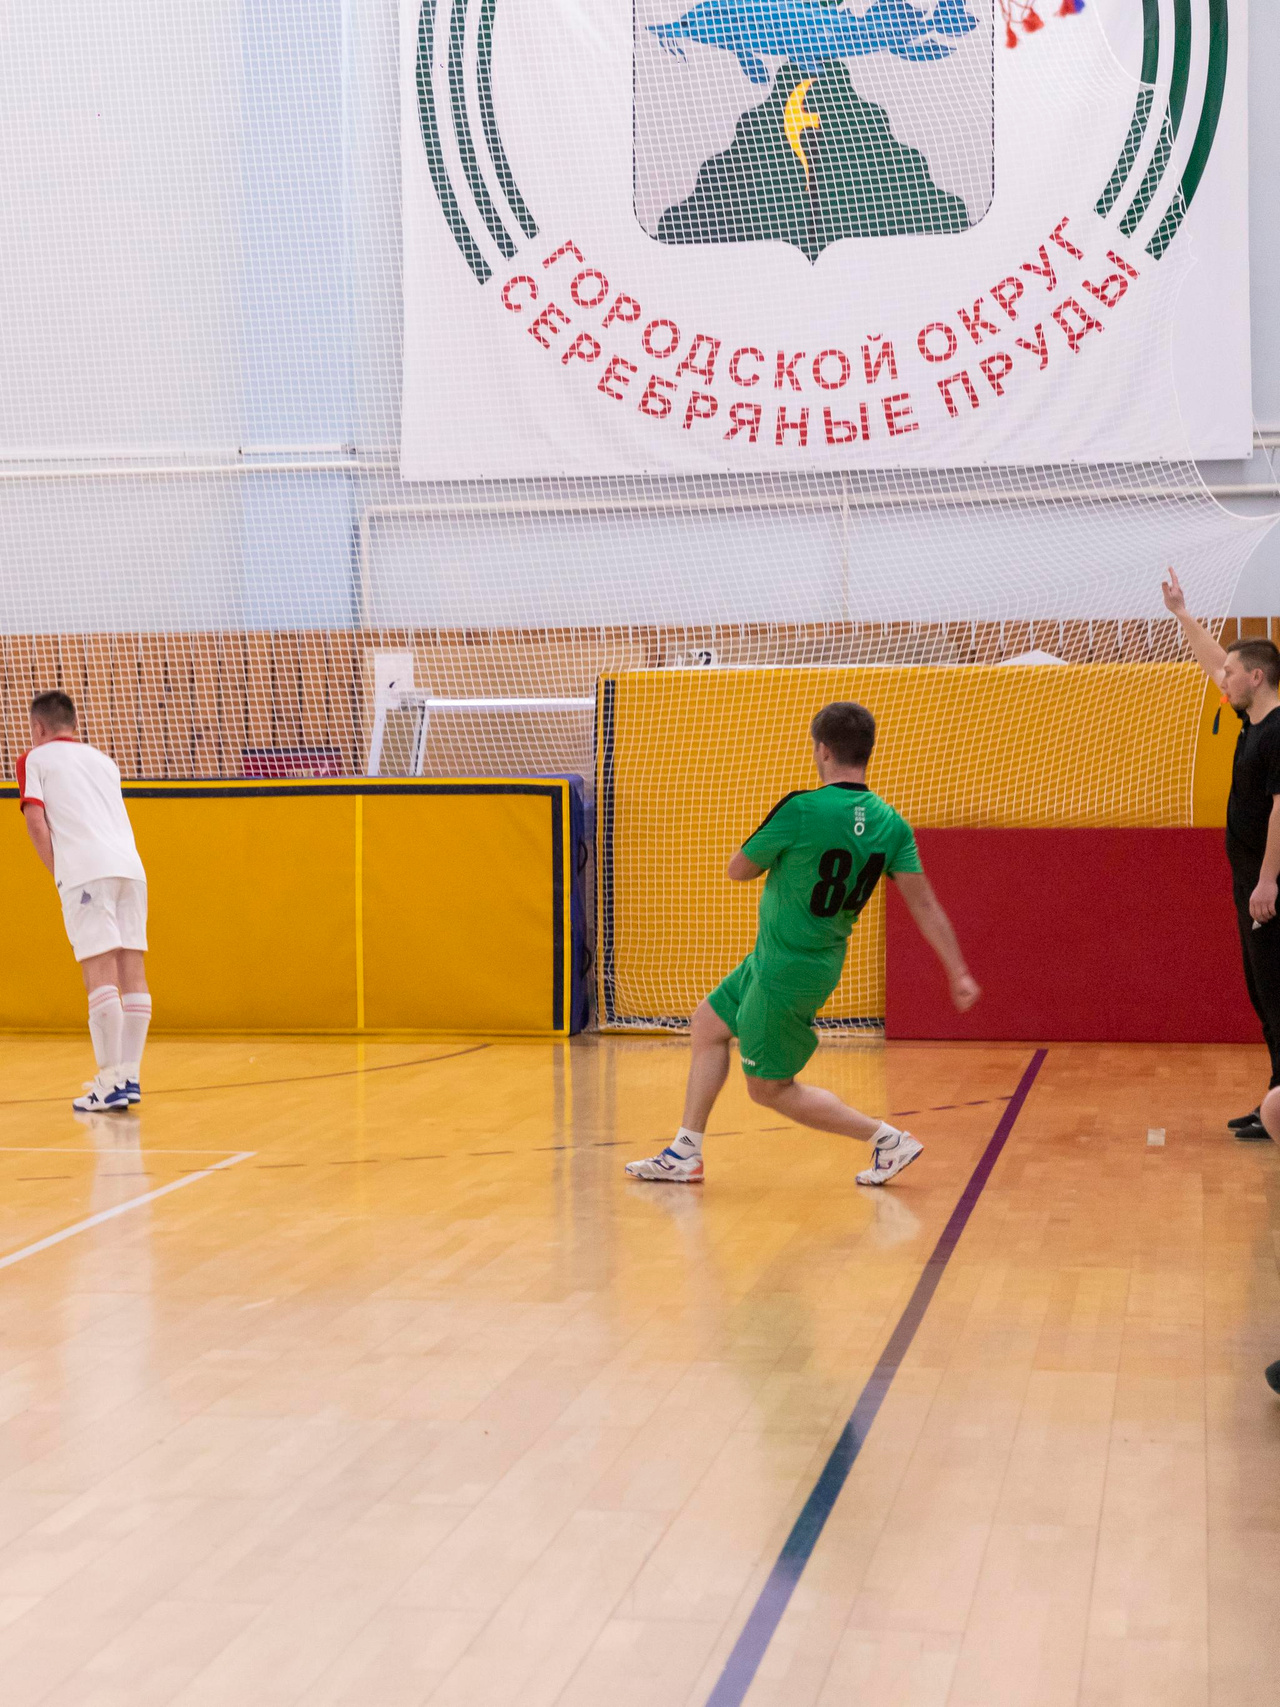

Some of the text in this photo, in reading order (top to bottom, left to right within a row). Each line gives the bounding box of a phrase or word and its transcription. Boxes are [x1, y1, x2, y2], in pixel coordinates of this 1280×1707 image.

[500, 249, 1141, 448] СЕРЕБРЯНЫЕ ПРУДЫ
[542, 216, 1085, 394] ГОРОДСКОЙ ОКРУГ
[810, 848, 886, 918] 84
